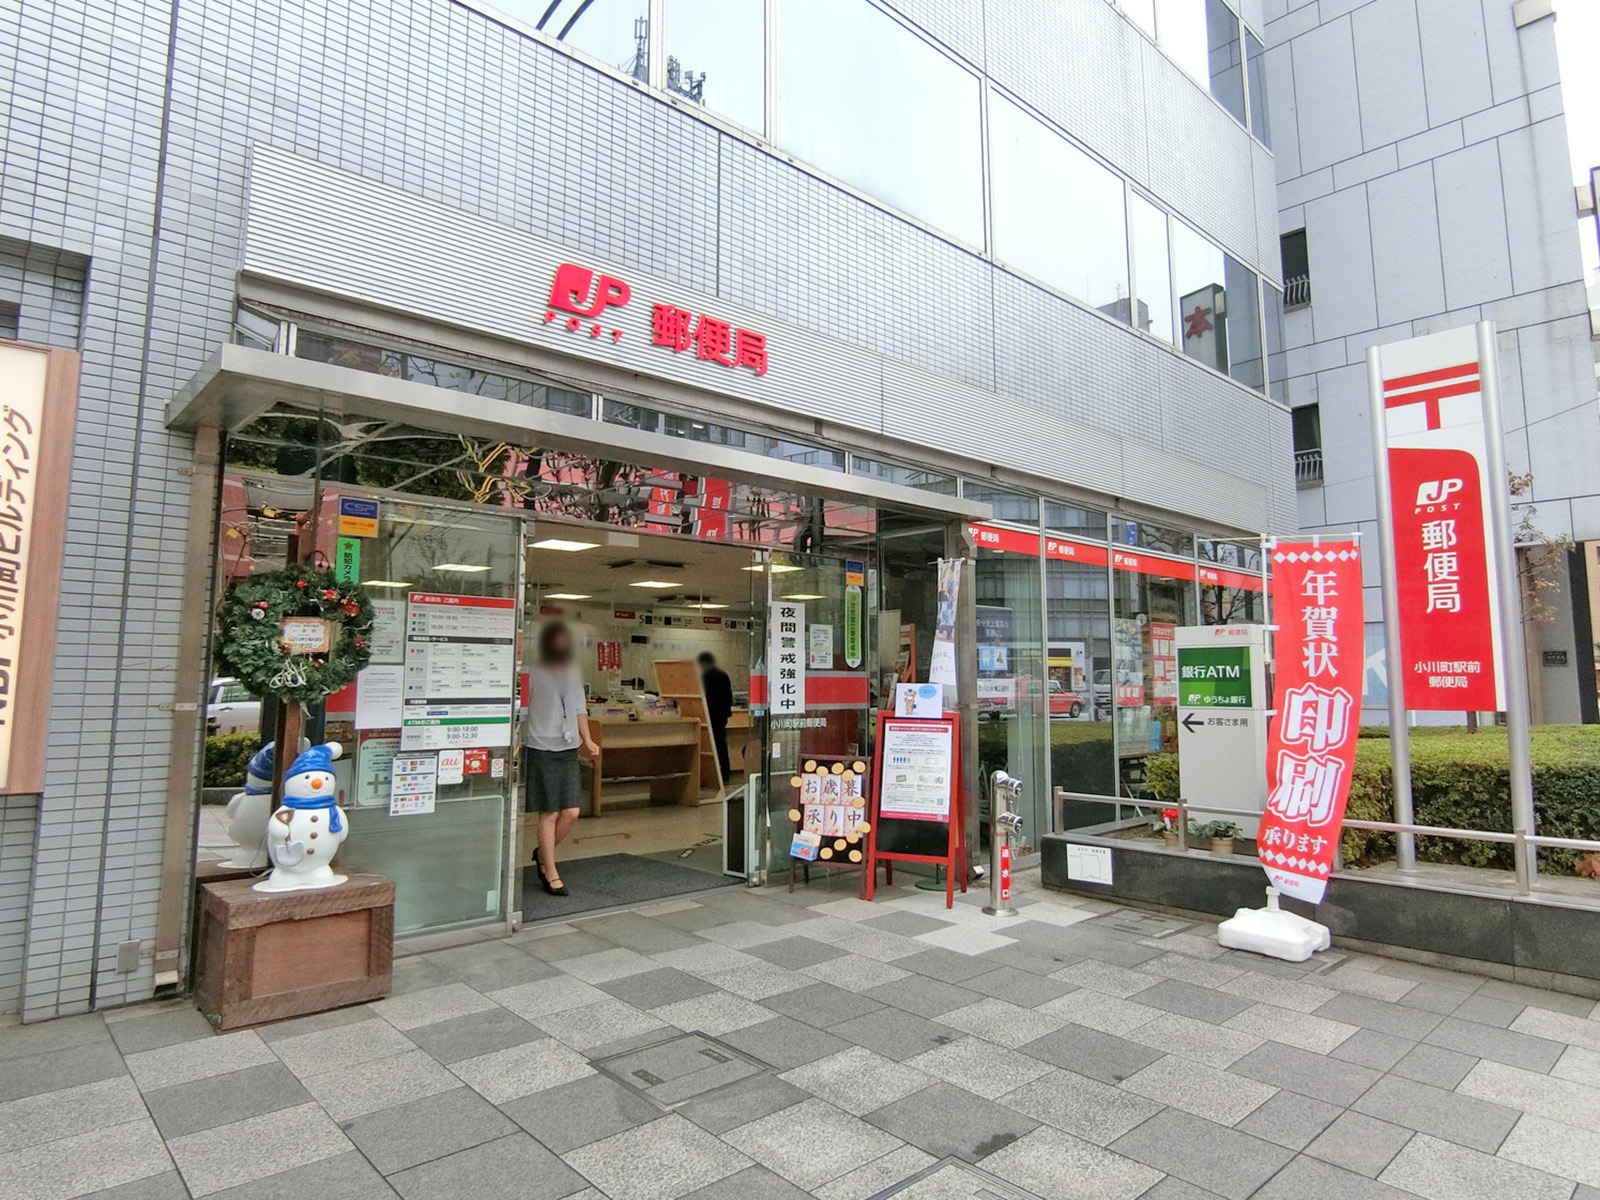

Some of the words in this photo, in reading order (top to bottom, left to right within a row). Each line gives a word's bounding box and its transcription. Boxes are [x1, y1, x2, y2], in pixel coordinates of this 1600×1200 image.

[543, 309, 624, 344] POST
[549, 262, 631, 318] JP
[651, 302, 768, 376] 郵便局
[1416, 478, 1463, 506] JP
[1414, 503, 1461, 514] POST
[1421, 519, 1461, 614] 郵便局
[1301, 570, 1339, 678] 年賀状
[780, 606, 797, 710] 夜間警戒強化中
[1414, 661, 1481, 674] 小川町駅前
[1181, 665, 1240, 678] 銀行ATM
[1428, 676, 1468, 688] 郵便局
[1203, 695, 1246, 704] ゆうちょ銀行
[770, 717, 827, 729] 小川町駅前郵便局
[1207, 717, 1248, 727] お客さま用
[441, 758, 460, 766] au
[1267, 682, 1353, 826] 印刷
[805, 779, 859, 798] お歳暮
[807, 809, 861, 828] 承り中
[1263, 825, 1328, 855] 承ります
